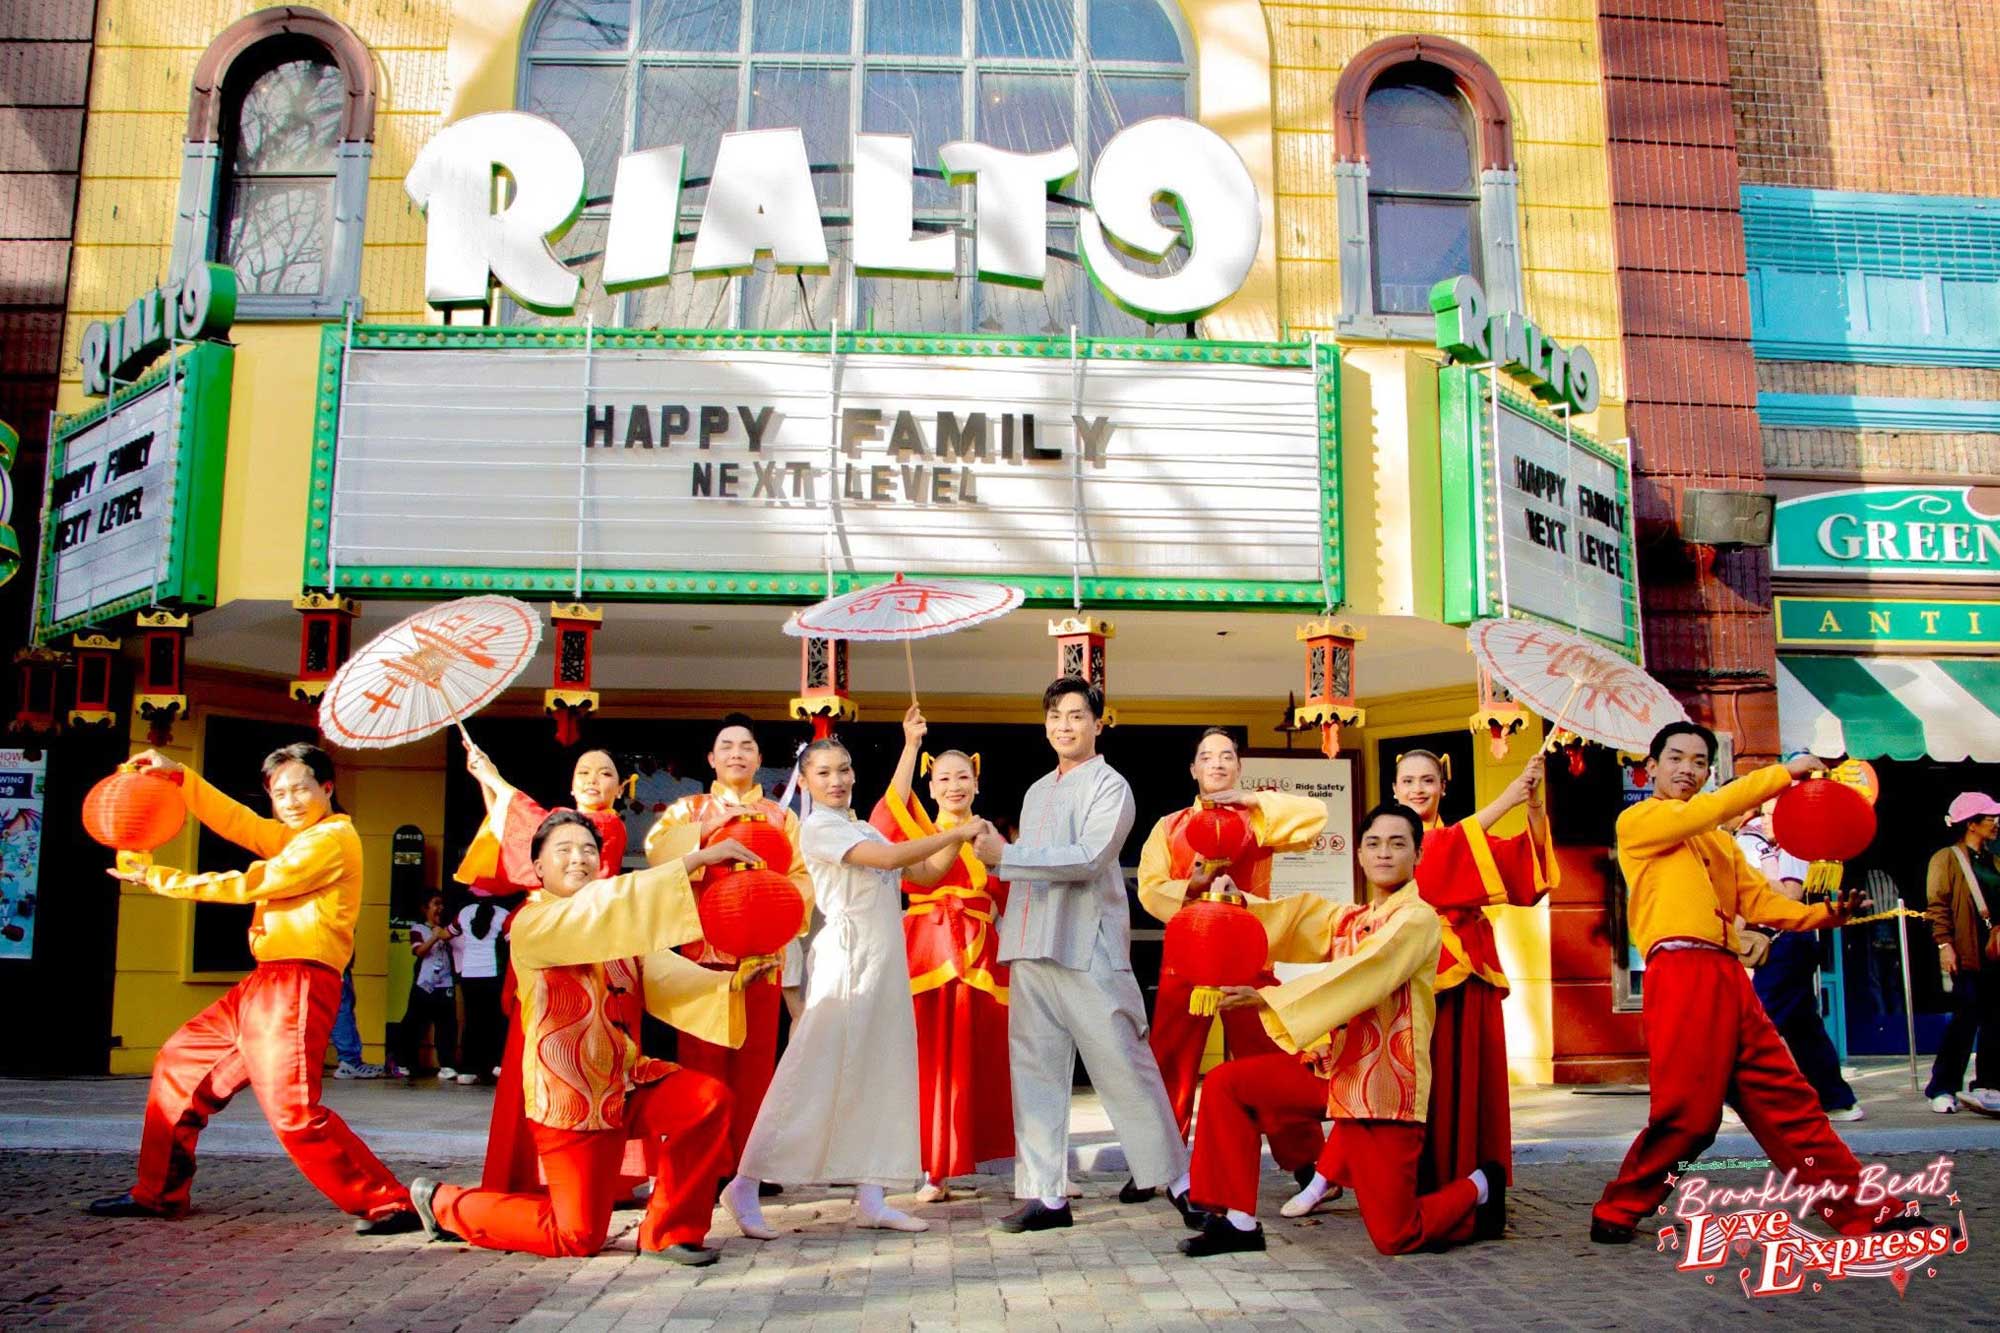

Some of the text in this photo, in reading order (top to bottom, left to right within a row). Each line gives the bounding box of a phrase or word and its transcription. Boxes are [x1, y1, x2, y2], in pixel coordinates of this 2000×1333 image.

[404, 110, 1262, 325] RIALTO
[82, 262, 217, 397] RIALTO
[1440, 275, 1600, 414] RIALTO
[586, 404, 1110, 463] HAPPY FAMILY
[97, 486, 144, 534] LEVEL
[692, 461, 978, 505] NEXT LEVEL
[1513, 454, 1624, 534] HAPPY FAMILY
[1524, 507, 1625, 579] NEXT LEVEL
[1818, 609, 1982, 634] ANTI
[1295, 783, 1345, 792] Ride Safety
